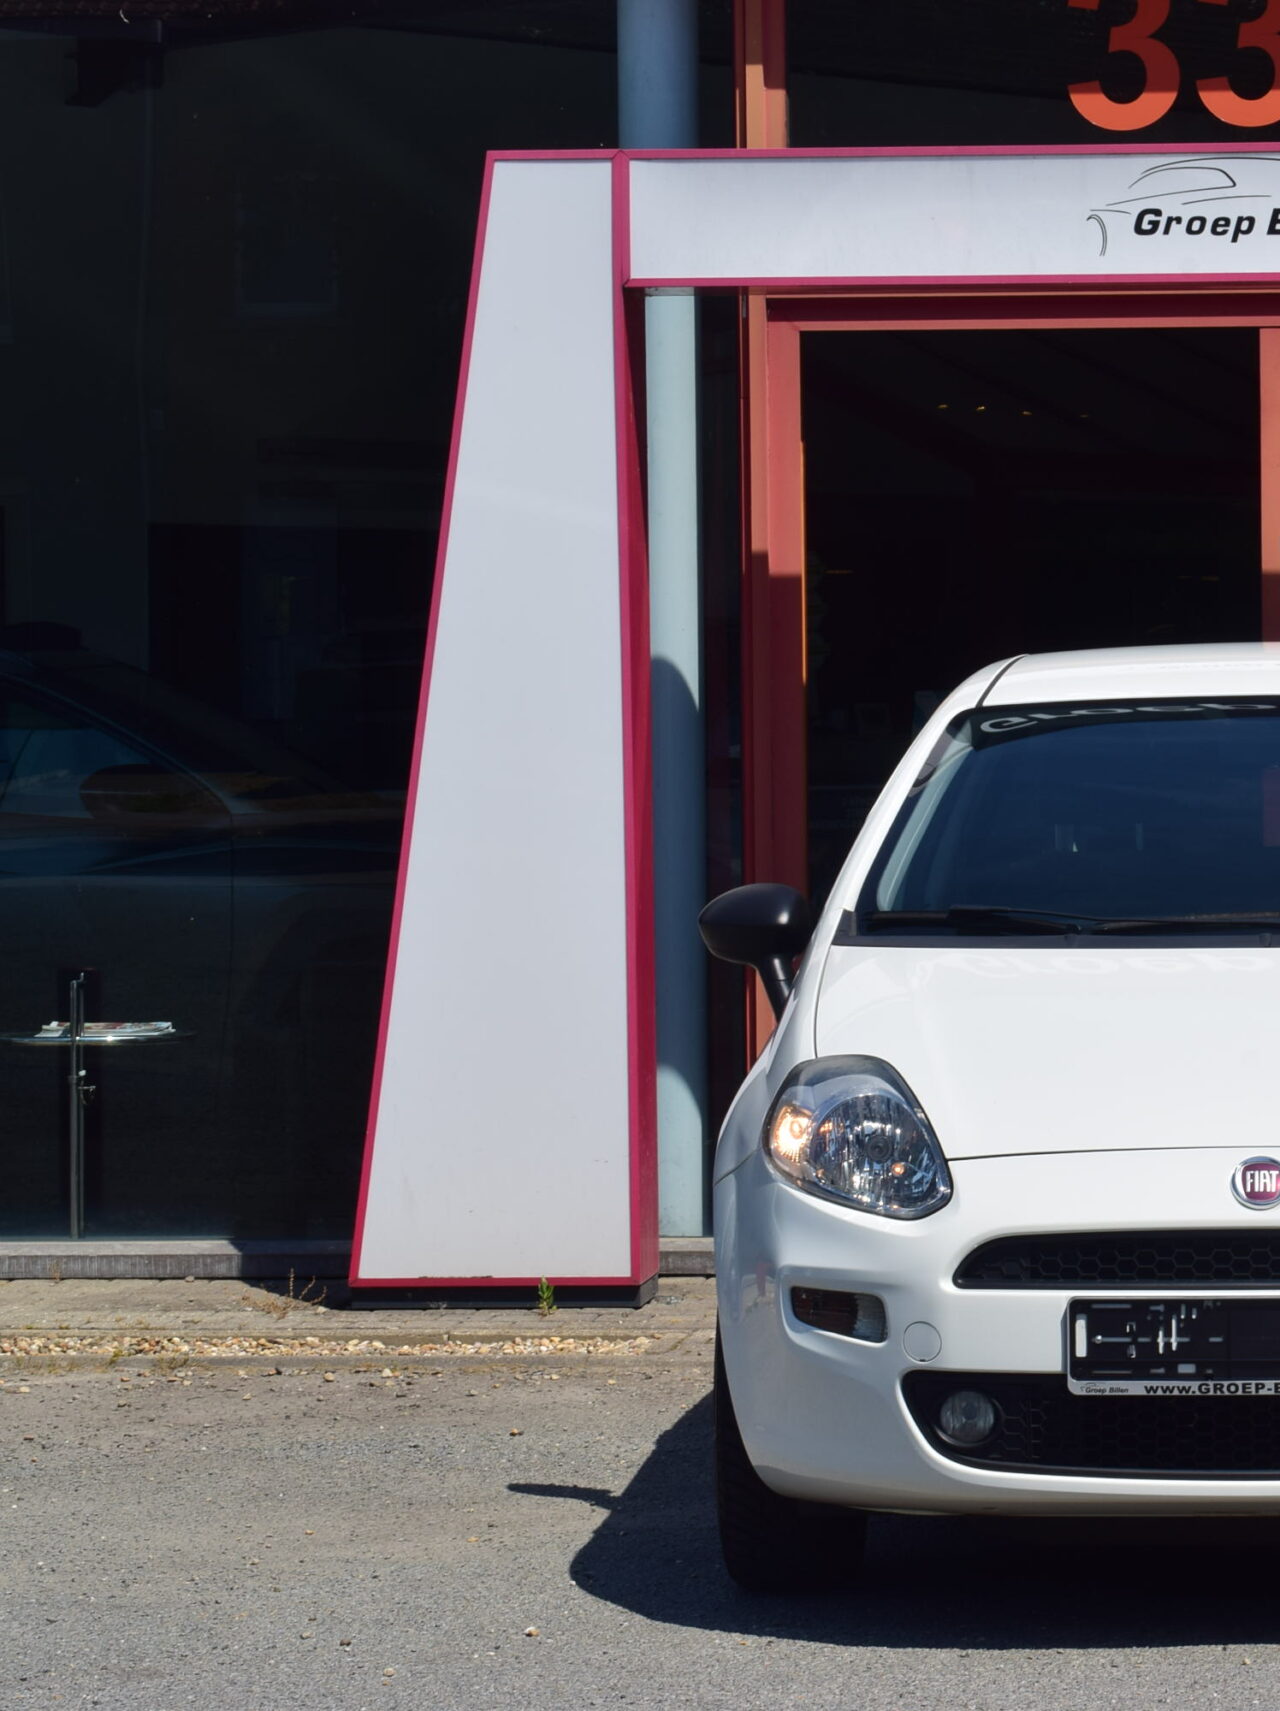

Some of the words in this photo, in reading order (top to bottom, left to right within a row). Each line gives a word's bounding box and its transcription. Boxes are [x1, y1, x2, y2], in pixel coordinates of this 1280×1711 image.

[1134, 207, 1256, 243] Groep
[1246, 1170, 1279, 1192] FIAT
[1085, 1386, 1107, 1394] Groep
